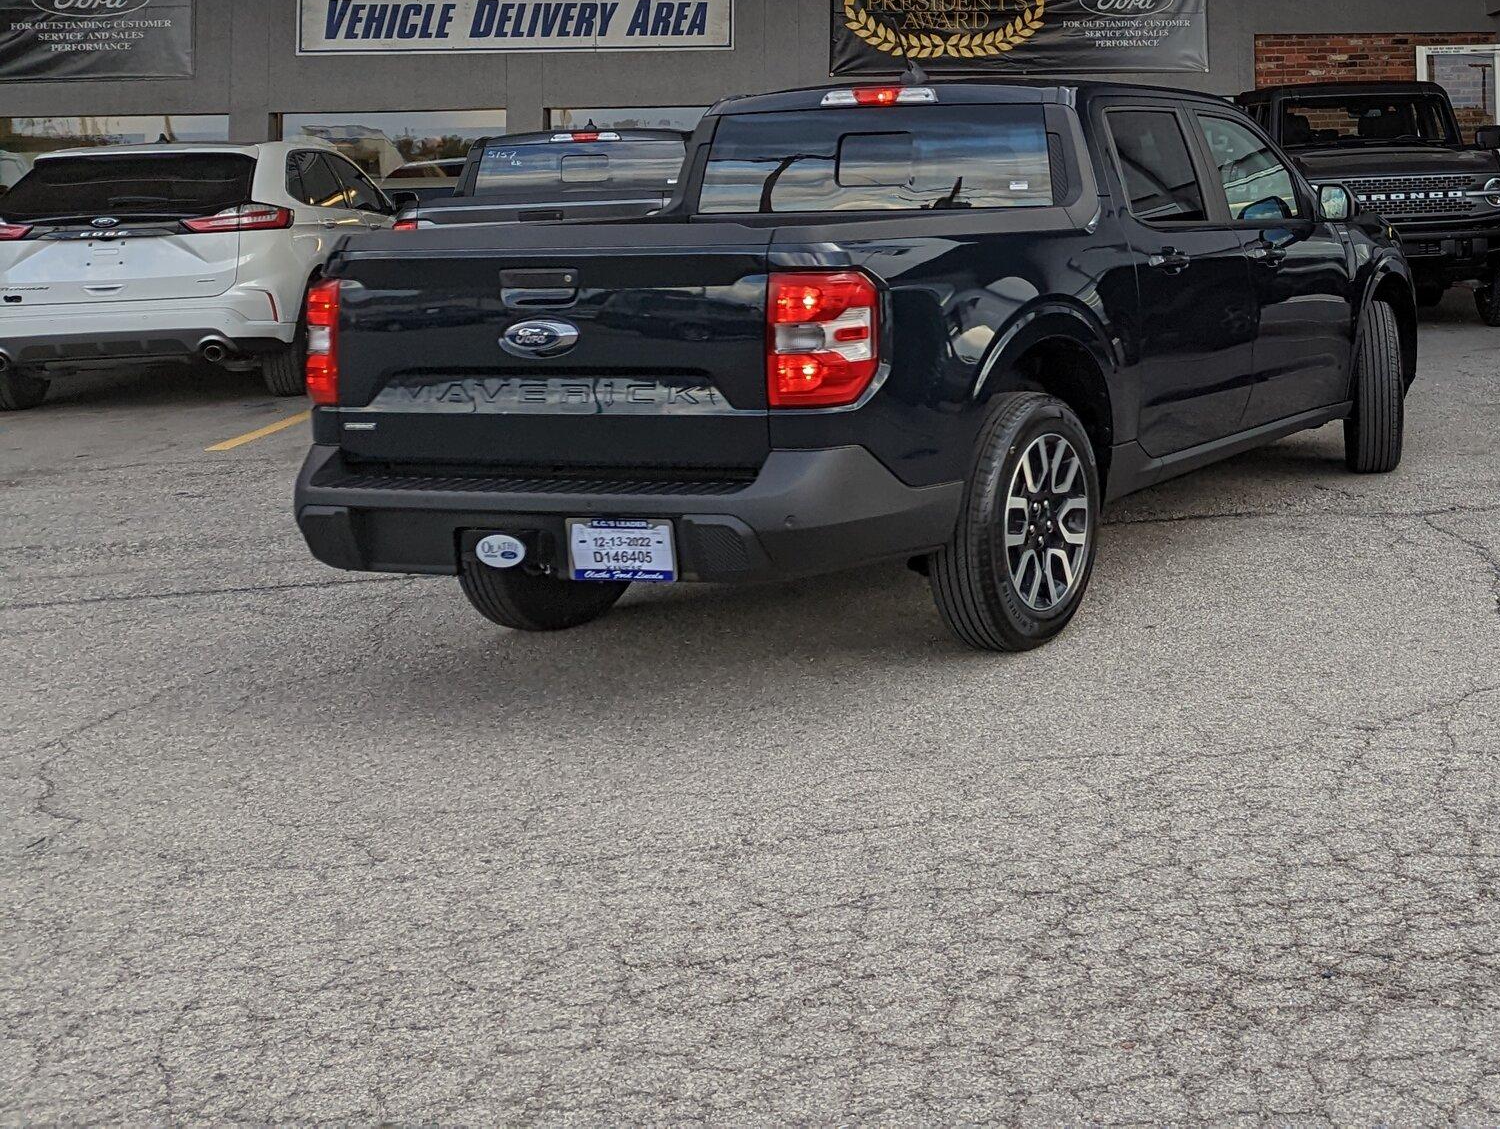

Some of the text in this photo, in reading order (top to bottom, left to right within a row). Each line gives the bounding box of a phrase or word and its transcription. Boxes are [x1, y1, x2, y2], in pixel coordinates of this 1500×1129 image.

[324, 0, 456, 39] VEHICLE
[902, 11, 989, 29] AWARD
[1083, 20, 1142, 28] OUTSTANDING
[35, 21, 110, 30] OUTSTANDING
[114, 20, 171, 29] CUSTOMER
[38, 31, 144, 41] SERVICE AND SALES
[1085, 30, 1122, 38] SERVICE
[51, 43, 132, 52] PERFORMANCE
[402, 381, 705, 406] MAVERICK
[593, 537, 652, 547] 12-13-2022
[593, 551, 653, 563] D146405
[584, 571, 664, 579] Olathe Ford Lincoln
